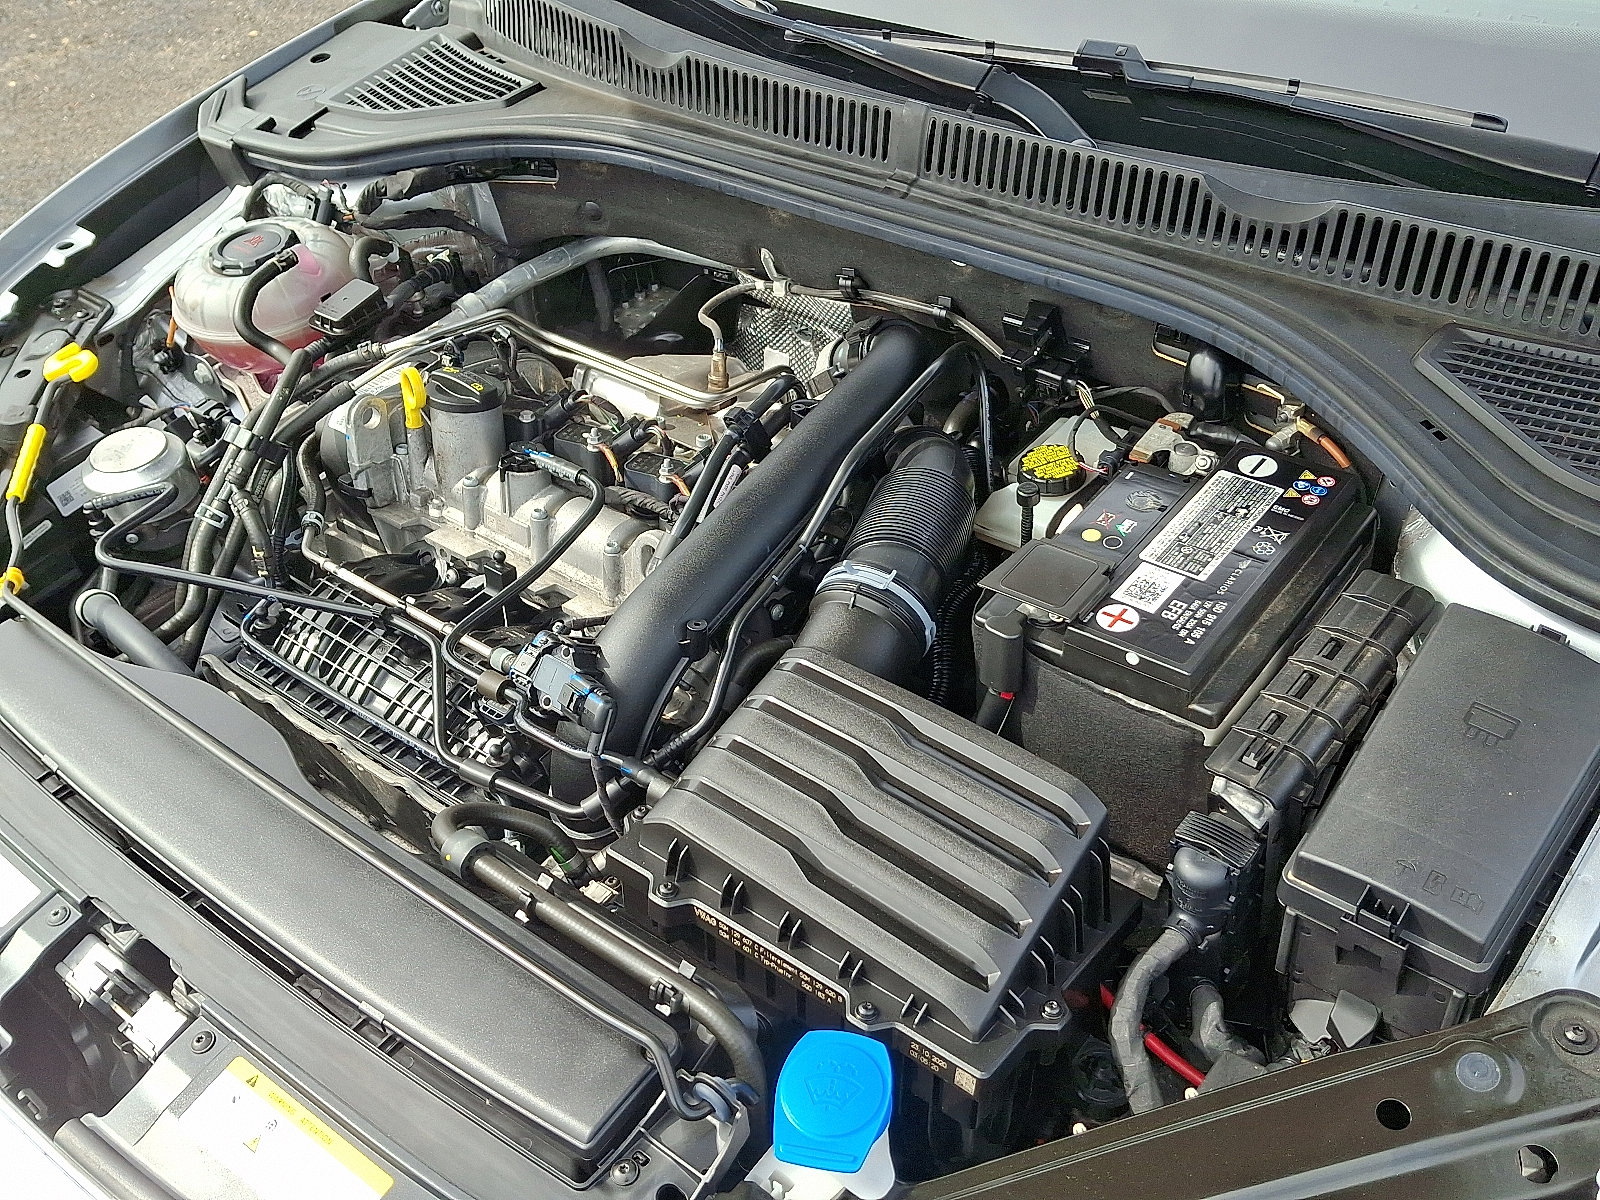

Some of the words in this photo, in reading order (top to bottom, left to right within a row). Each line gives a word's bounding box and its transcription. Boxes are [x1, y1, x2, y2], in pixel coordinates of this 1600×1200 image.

[1216, 568, 1242, 595] CLARIOS
[1161, 599, 1188, 621] EFB
[1183, 637, 1196, 645] A
[300, 1117, 333, 1146] ATTENTION
